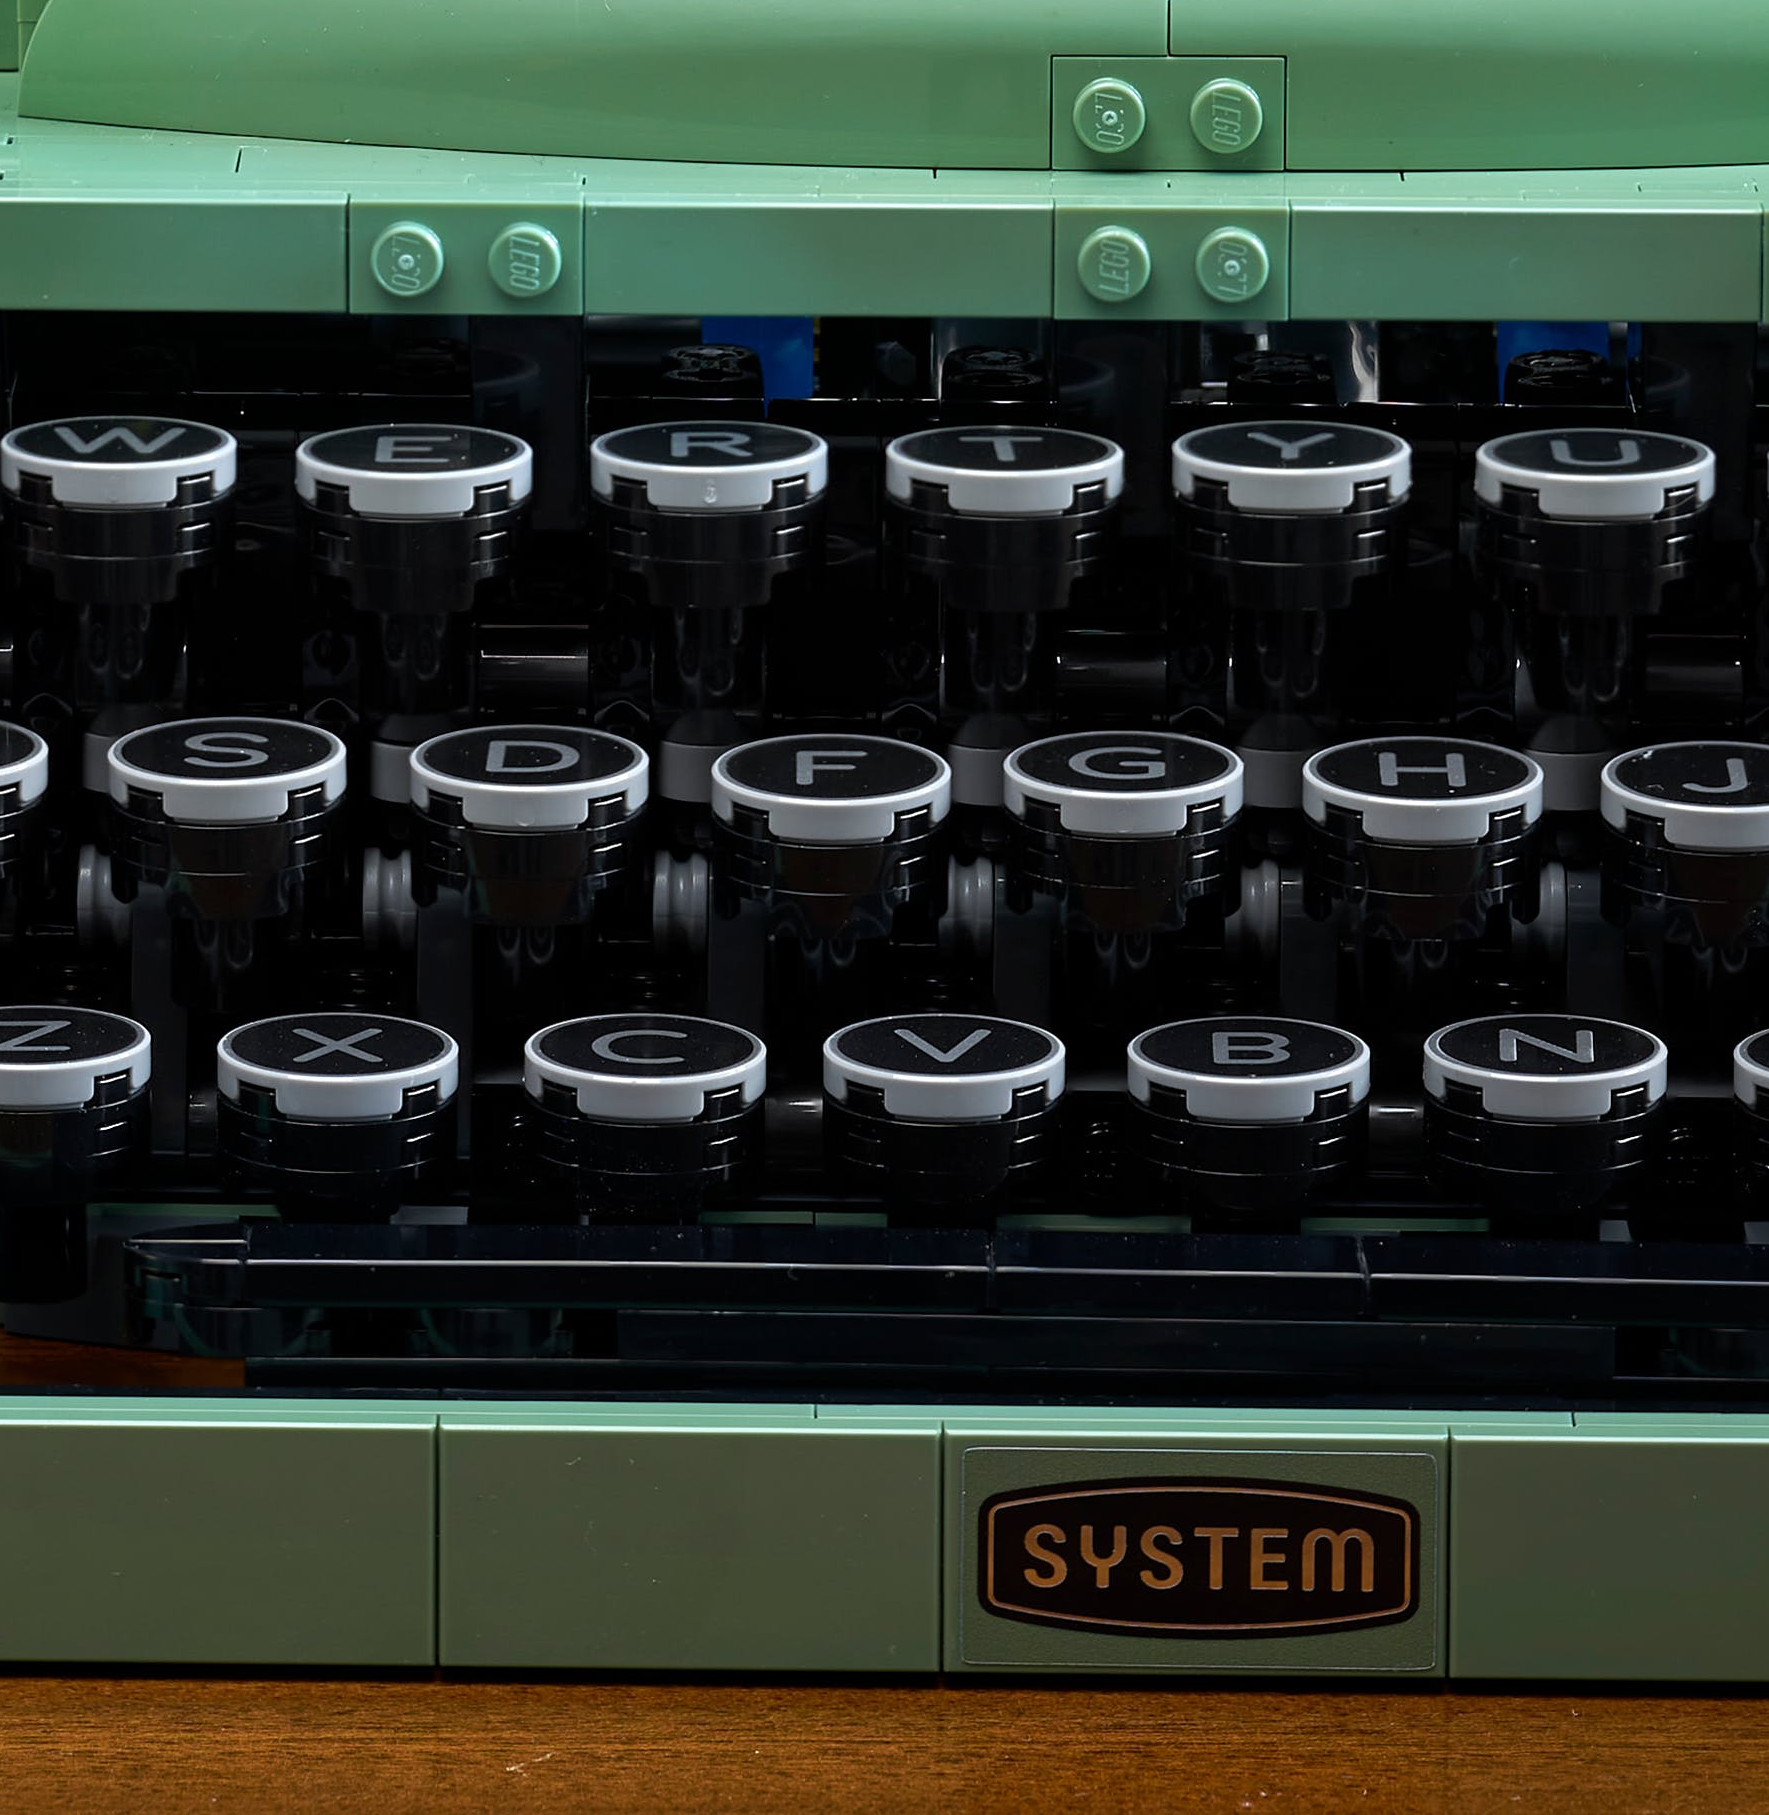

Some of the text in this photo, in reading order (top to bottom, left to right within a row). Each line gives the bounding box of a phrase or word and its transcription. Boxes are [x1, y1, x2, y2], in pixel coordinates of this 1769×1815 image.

[1213, 92, 1242, 146] LEGO
[510, 236, 540, 290] LEGO
[1099, 239, 1130, 295] LEGO
[53, 426, 186, 454] W
[375, 437, 451, 463] E
[671, 432, 752, 457] R
[960, 436, 1042, 461] T
[1247, 433, 1334, 460] Y
[1551, 440, 1640, 466] U
[184, 733, 269, 767] S
[486, 741, 579, 772] D
[1069, 747, 1165, 779] G
[796, 751, 867, 785] F
[1379, 752, 1466, 787] H
[1682, 759, 1748, 793] J
[293, 1029, 383, 1062] X
[592, 1030, 687, 1063] C
[894, 1029, 991, 1062] V
[1212, 1032, 1290, 1064] B
[1499, 1029, 1594, 1063] N
[1024, 1524, 1374, 1592] SYSTEM
